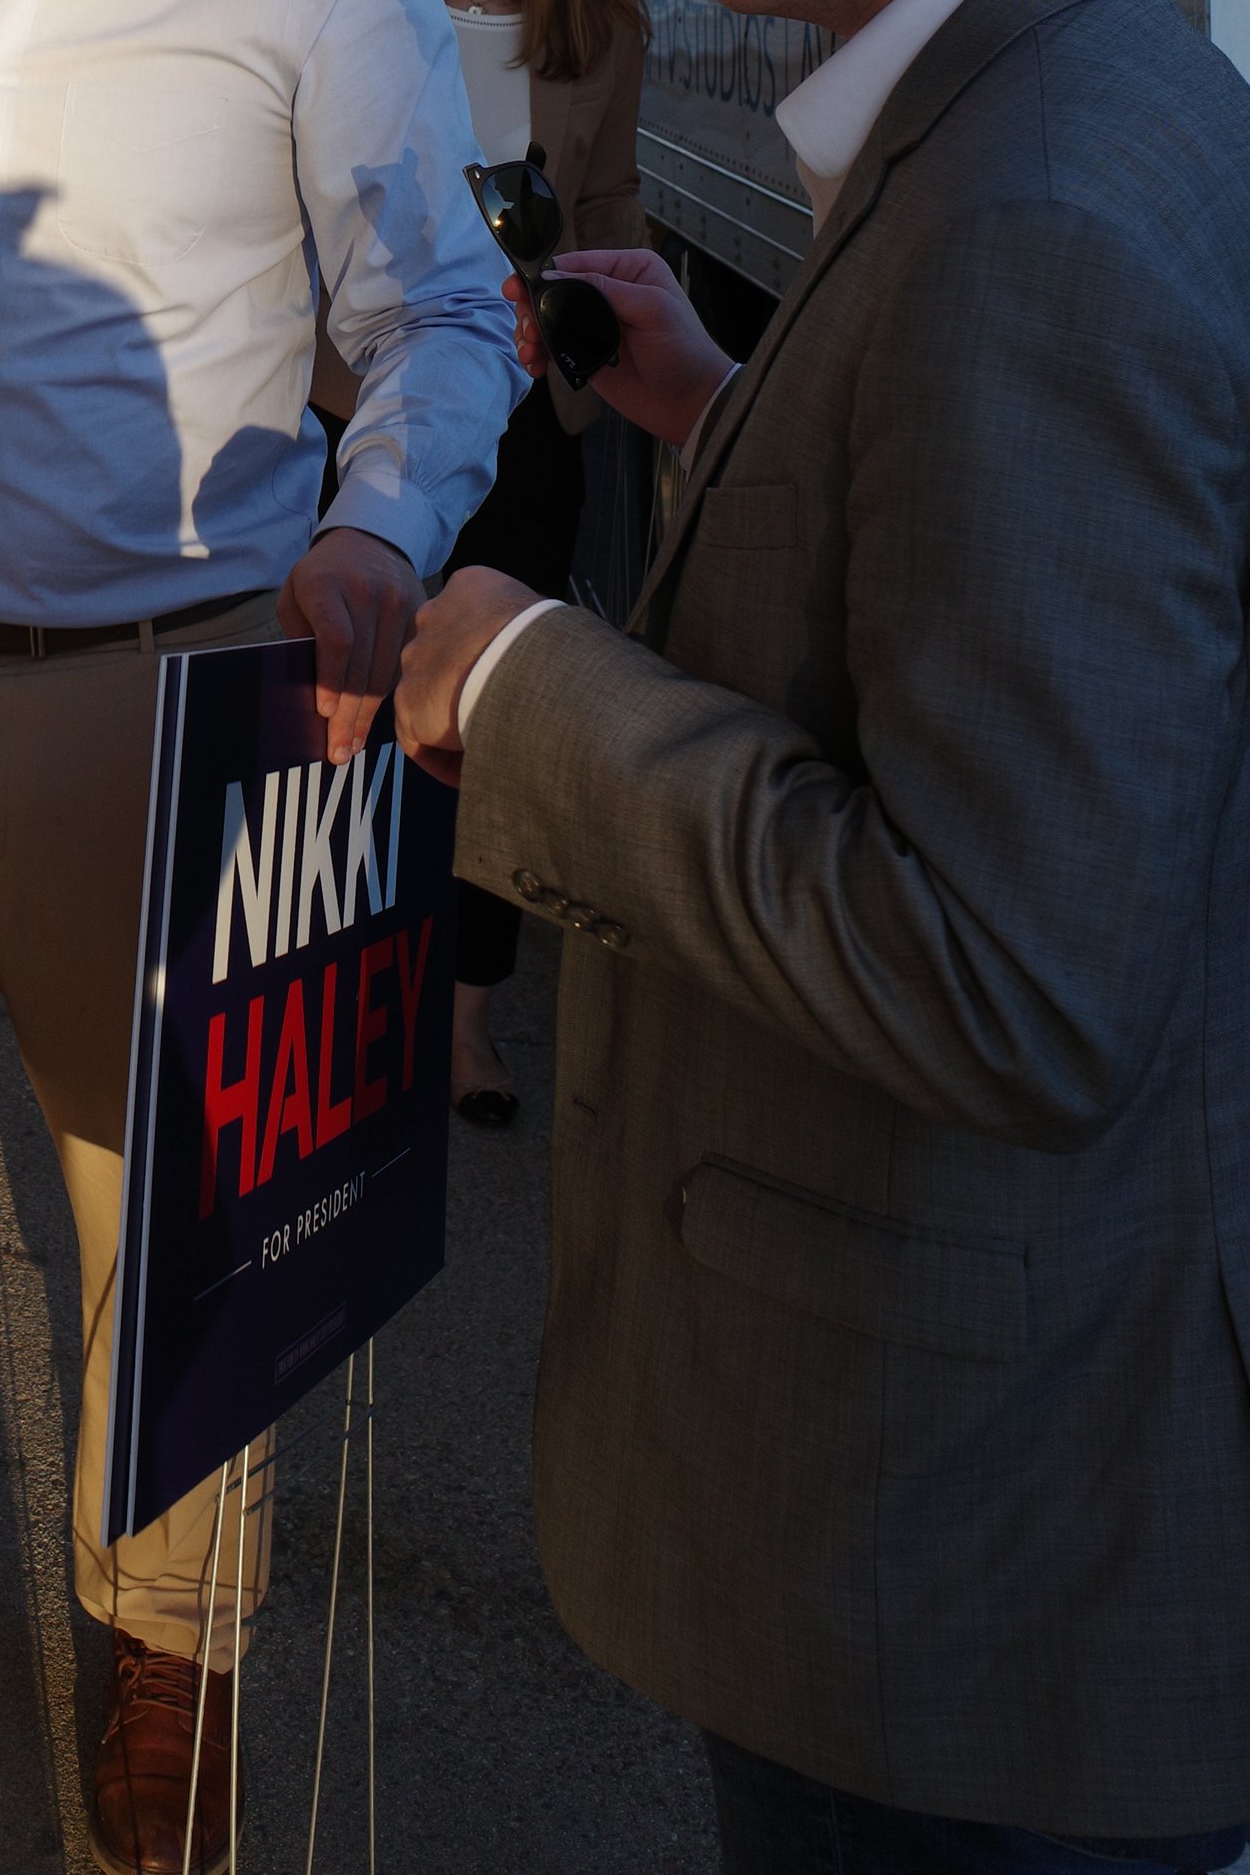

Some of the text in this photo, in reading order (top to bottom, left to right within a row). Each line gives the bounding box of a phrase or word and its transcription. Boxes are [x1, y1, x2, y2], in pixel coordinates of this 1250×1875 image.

[212, 741, 406, 985] NIKKI
[199, 915, 434, 1221] HALEY
[261, 1170, 367, 1270] FOR PRESIDENT
